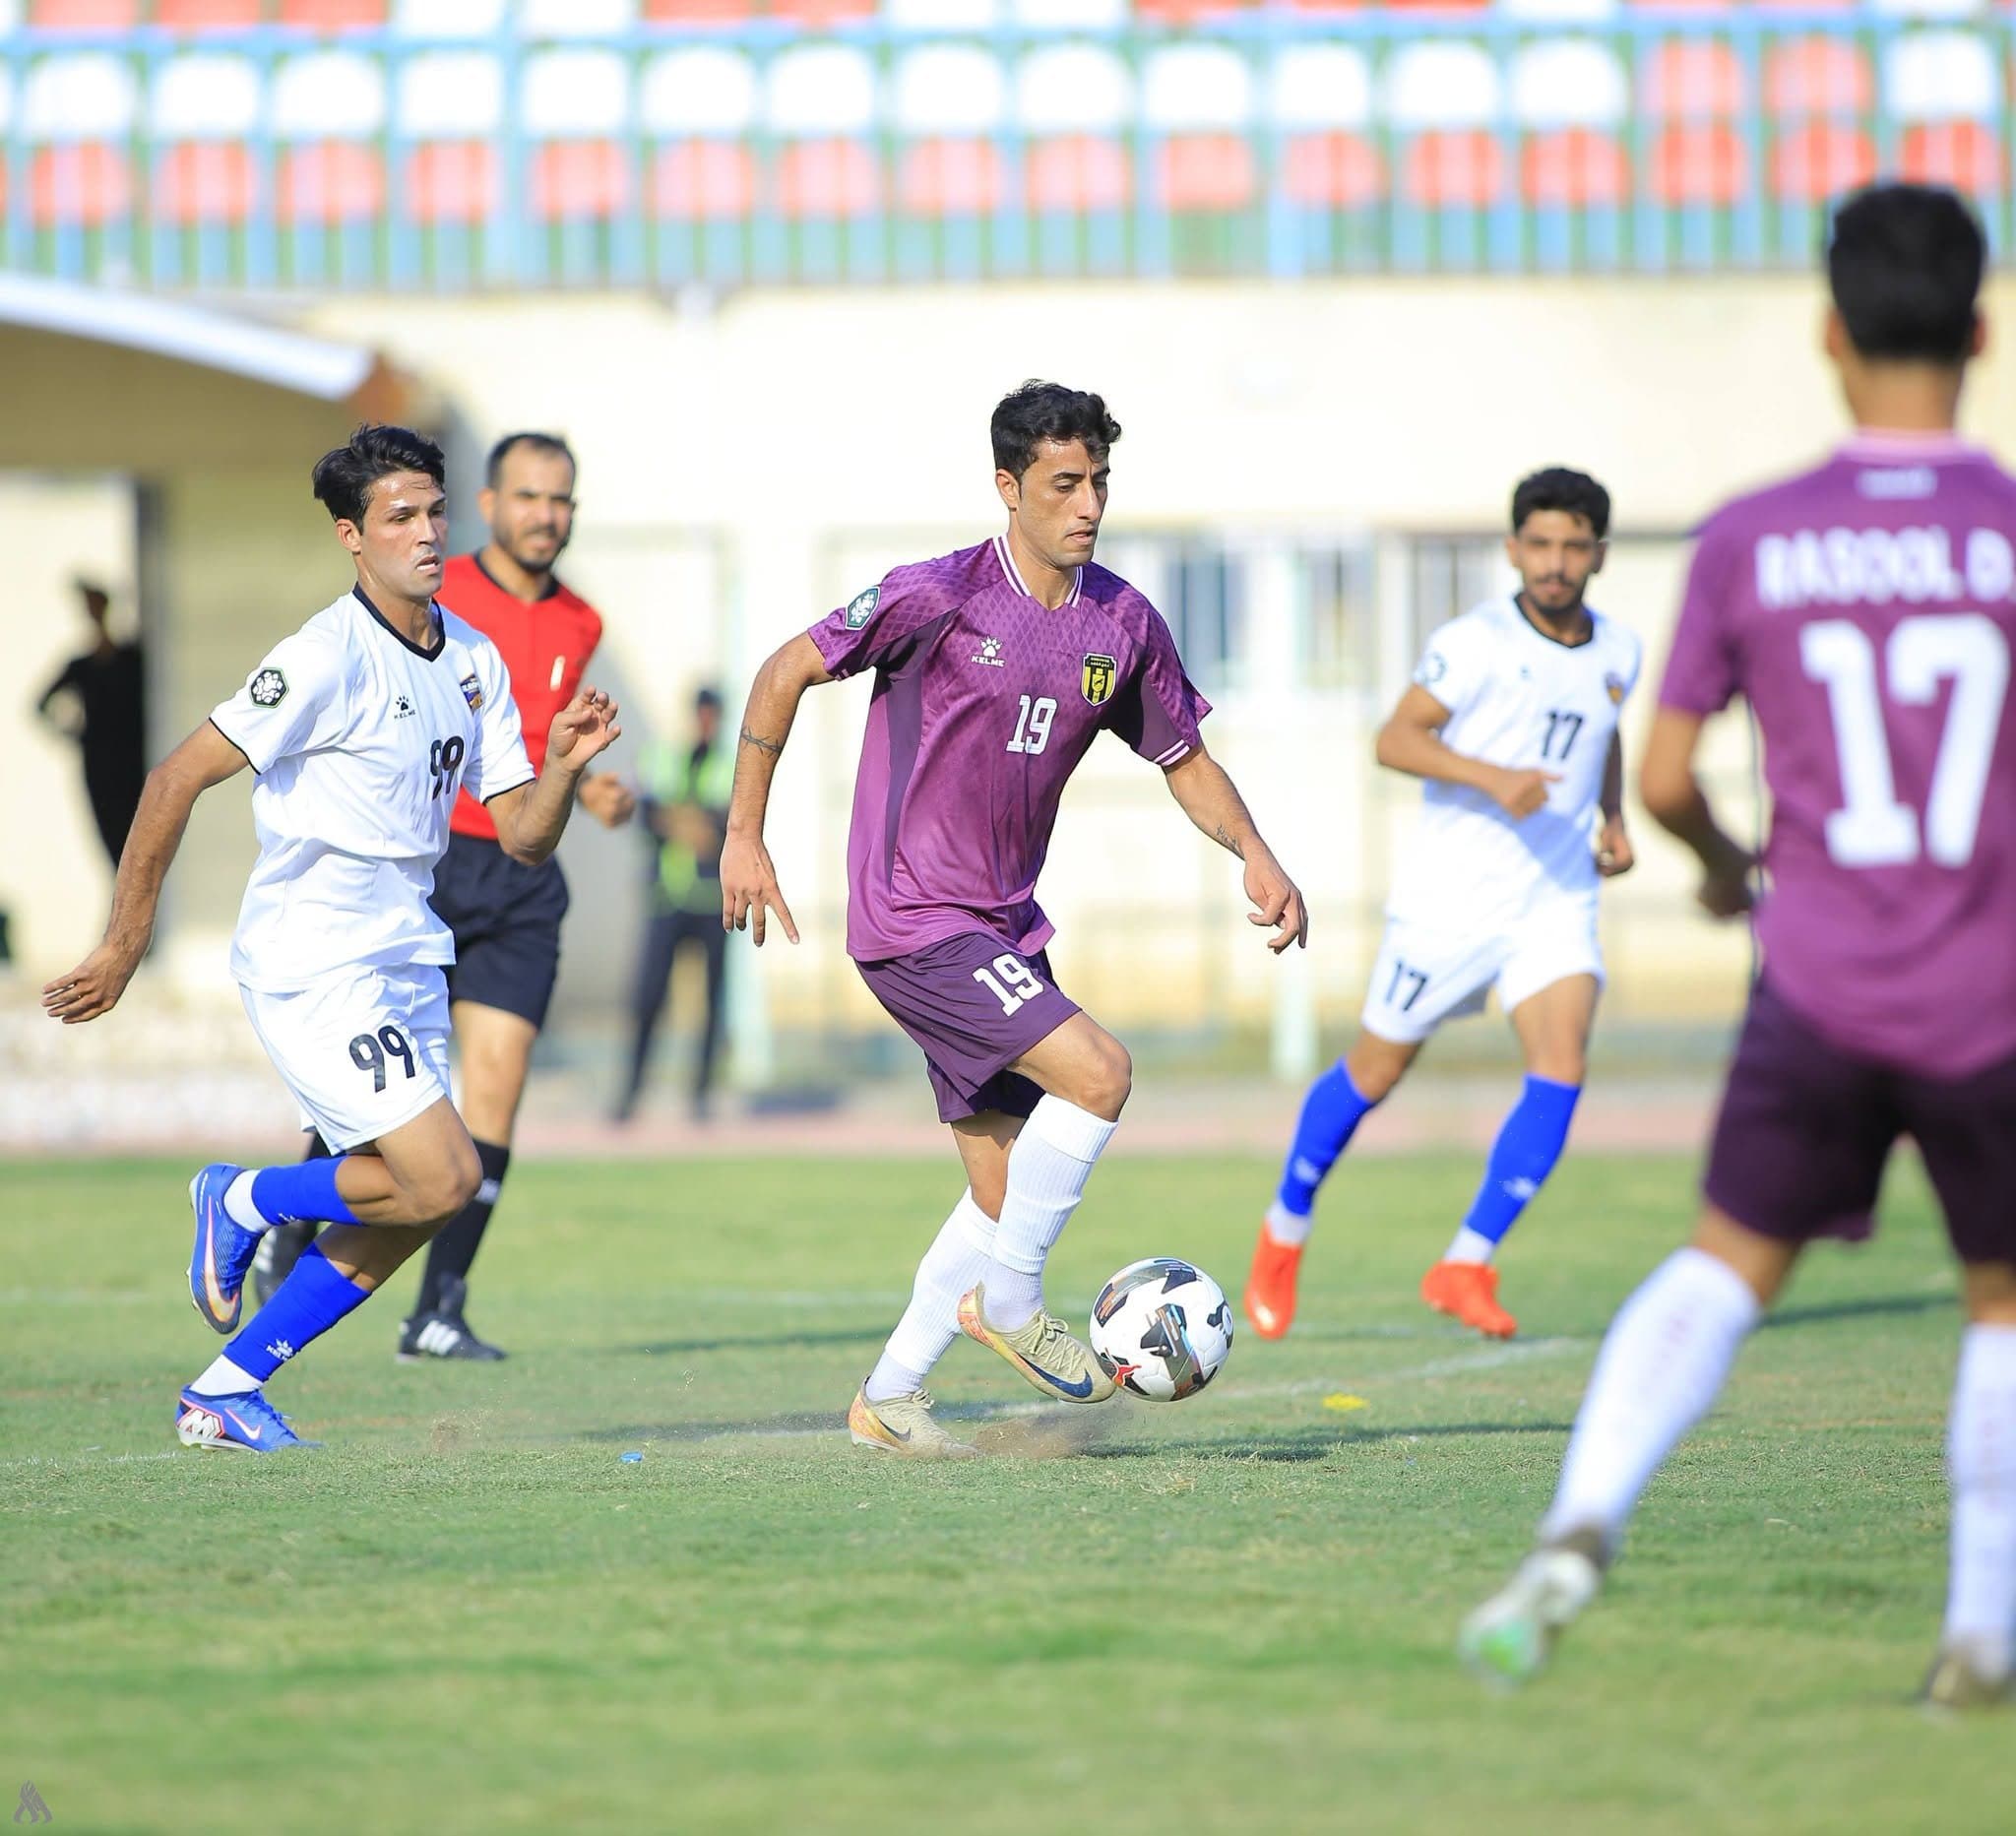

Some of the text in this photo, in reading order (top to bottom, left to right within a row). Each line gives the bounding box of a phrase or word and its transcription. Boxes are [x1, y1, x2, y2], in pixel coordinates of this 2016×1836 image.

[972, 656, 1005, 667] KELME
[1006, 694, 1057, 755] 19
[1541, 711, 1584, 761] 17
[1800, 616, 2011, 868] 17
[430, 736, 465, 800] 99
[972, 953, 1044, 1017] 19
[1385, 960, 1427, 1012] 17
[348, 1025, 415, 1093] 99
